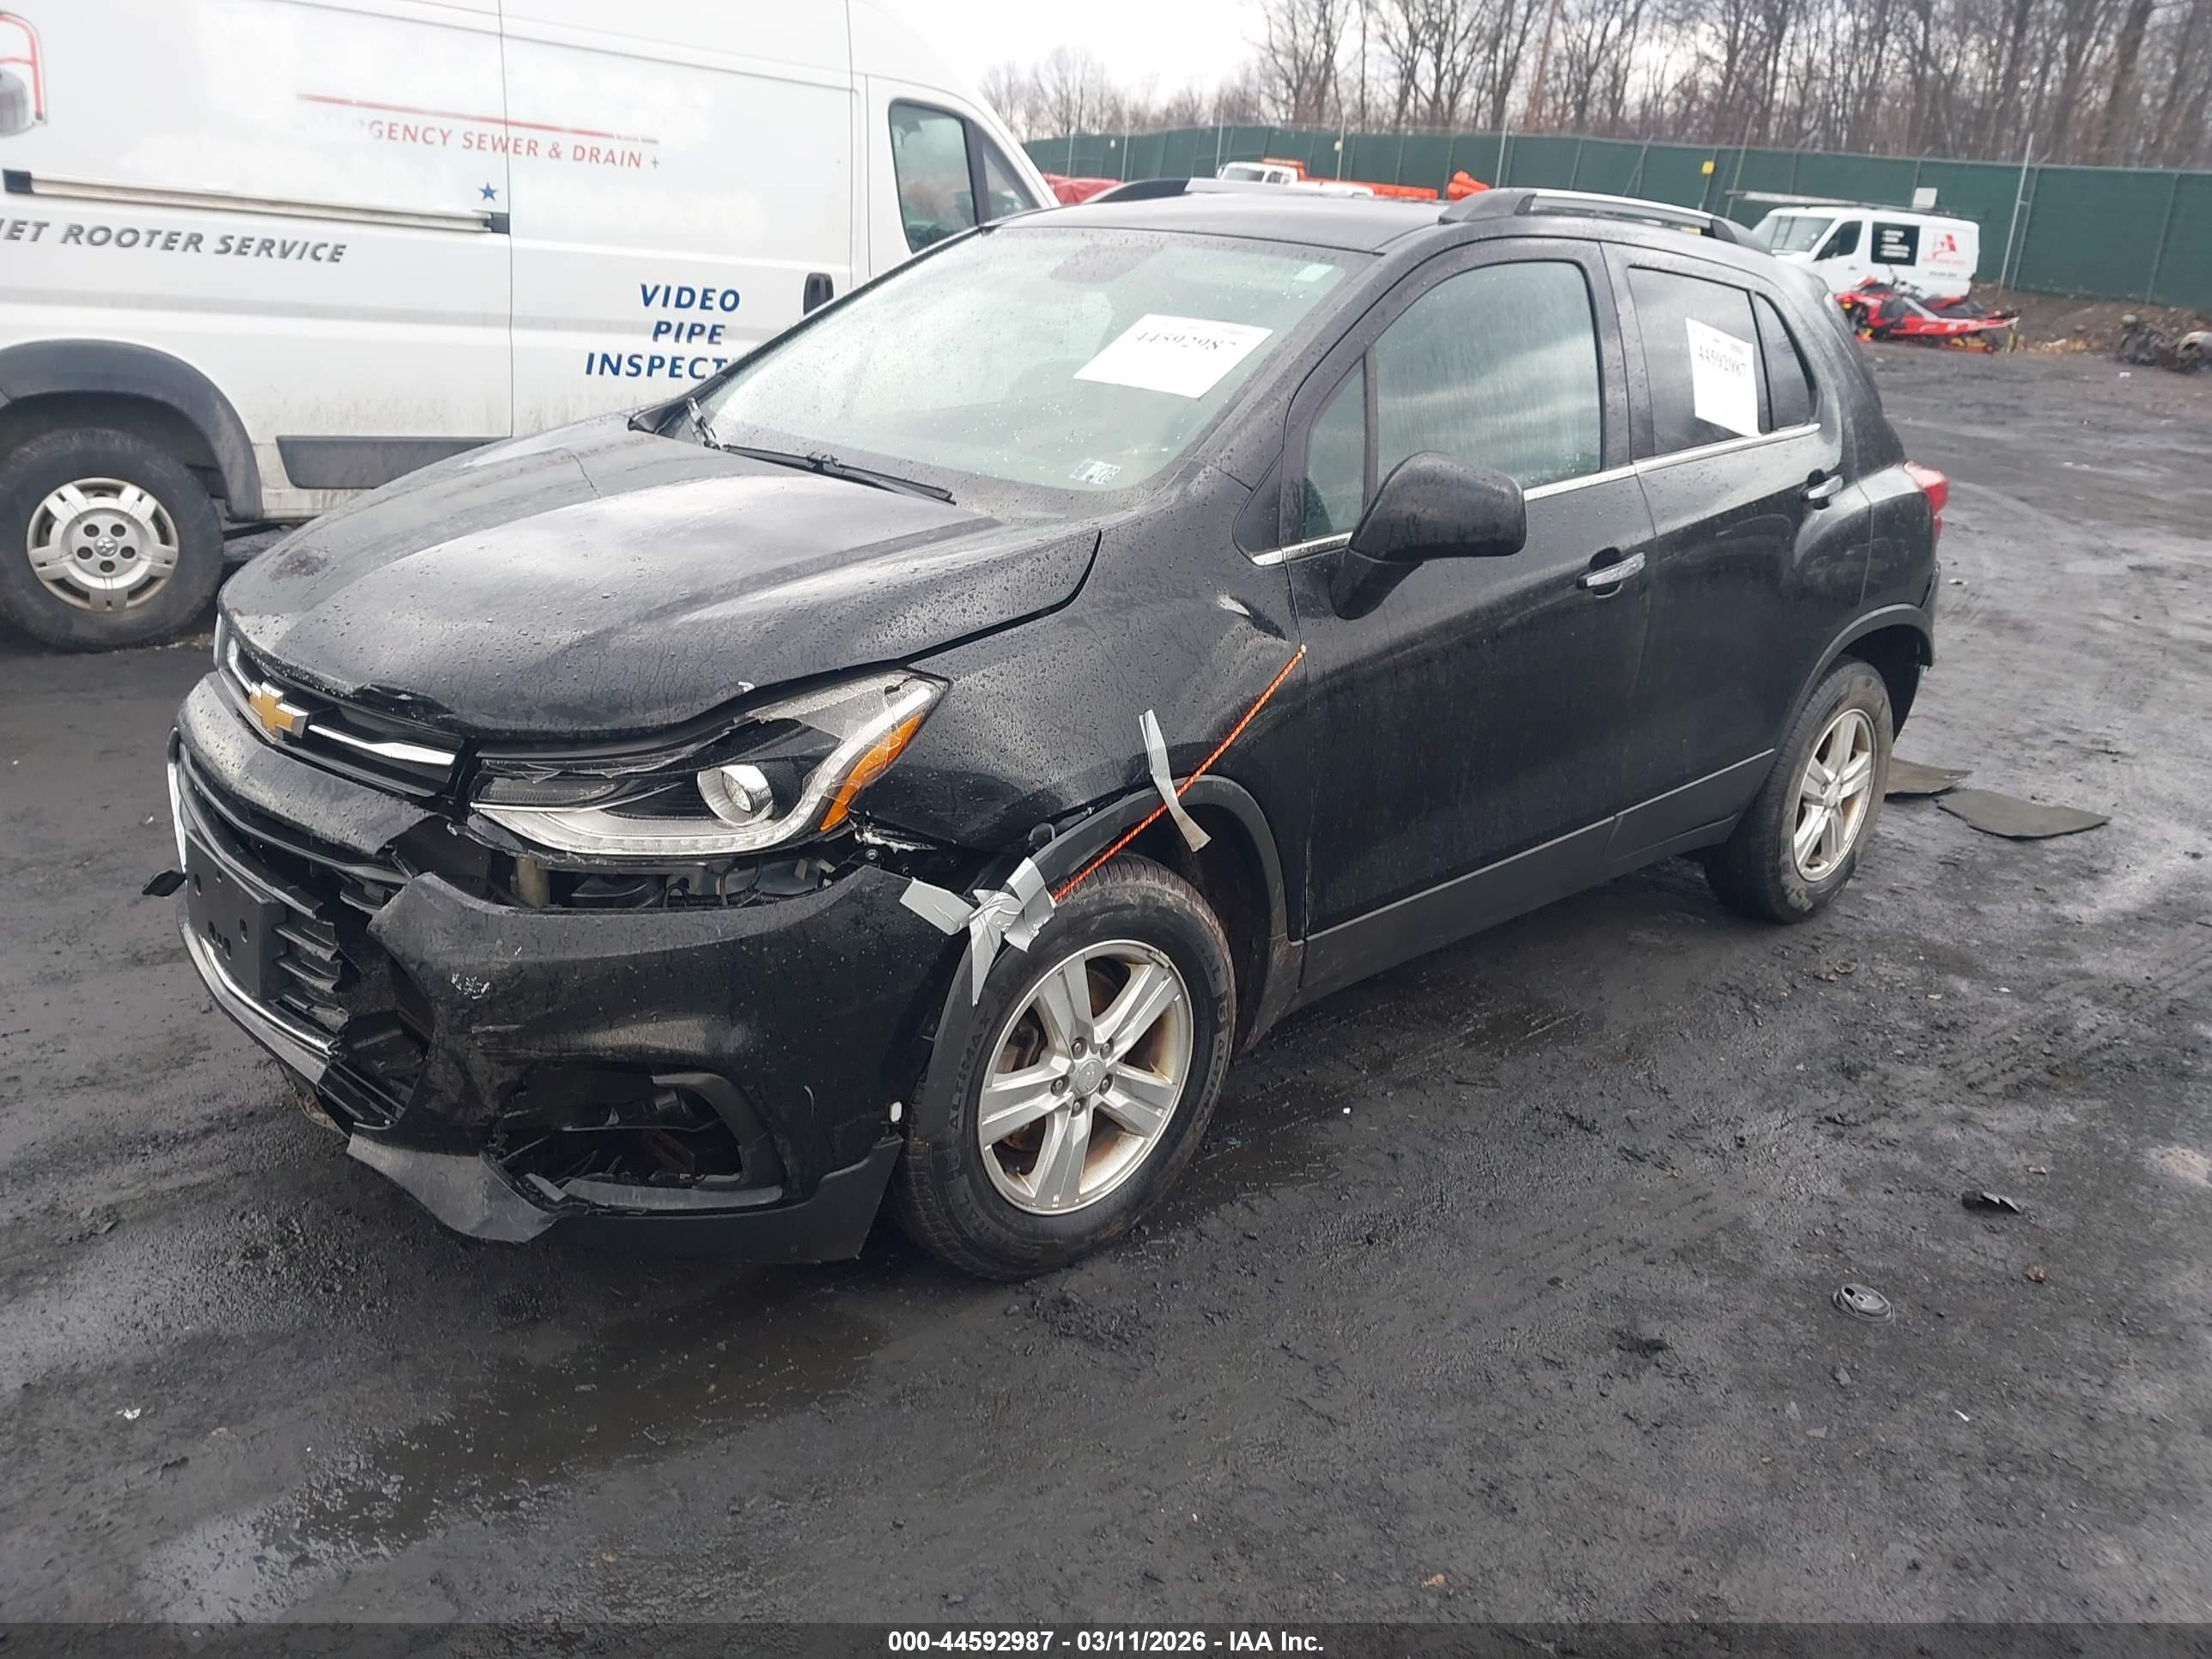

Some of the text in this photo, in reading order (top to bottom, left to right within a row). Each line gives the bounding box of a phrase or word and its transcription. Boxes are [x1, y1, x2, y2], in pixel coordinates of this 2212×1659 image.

[461, 131, 539, 157] SEWER
[547, 141, 563, 160] &
[572, 143, 642, 168] DRAIN
[60, 222, 204, 253] ROOTER
[214, 234, 347, 264] SERVICE
[640, 283, 740, 313] VIDEO
[653, 319, 726, 345] PIPE
[585, 352, 728, 380] INSPECT
